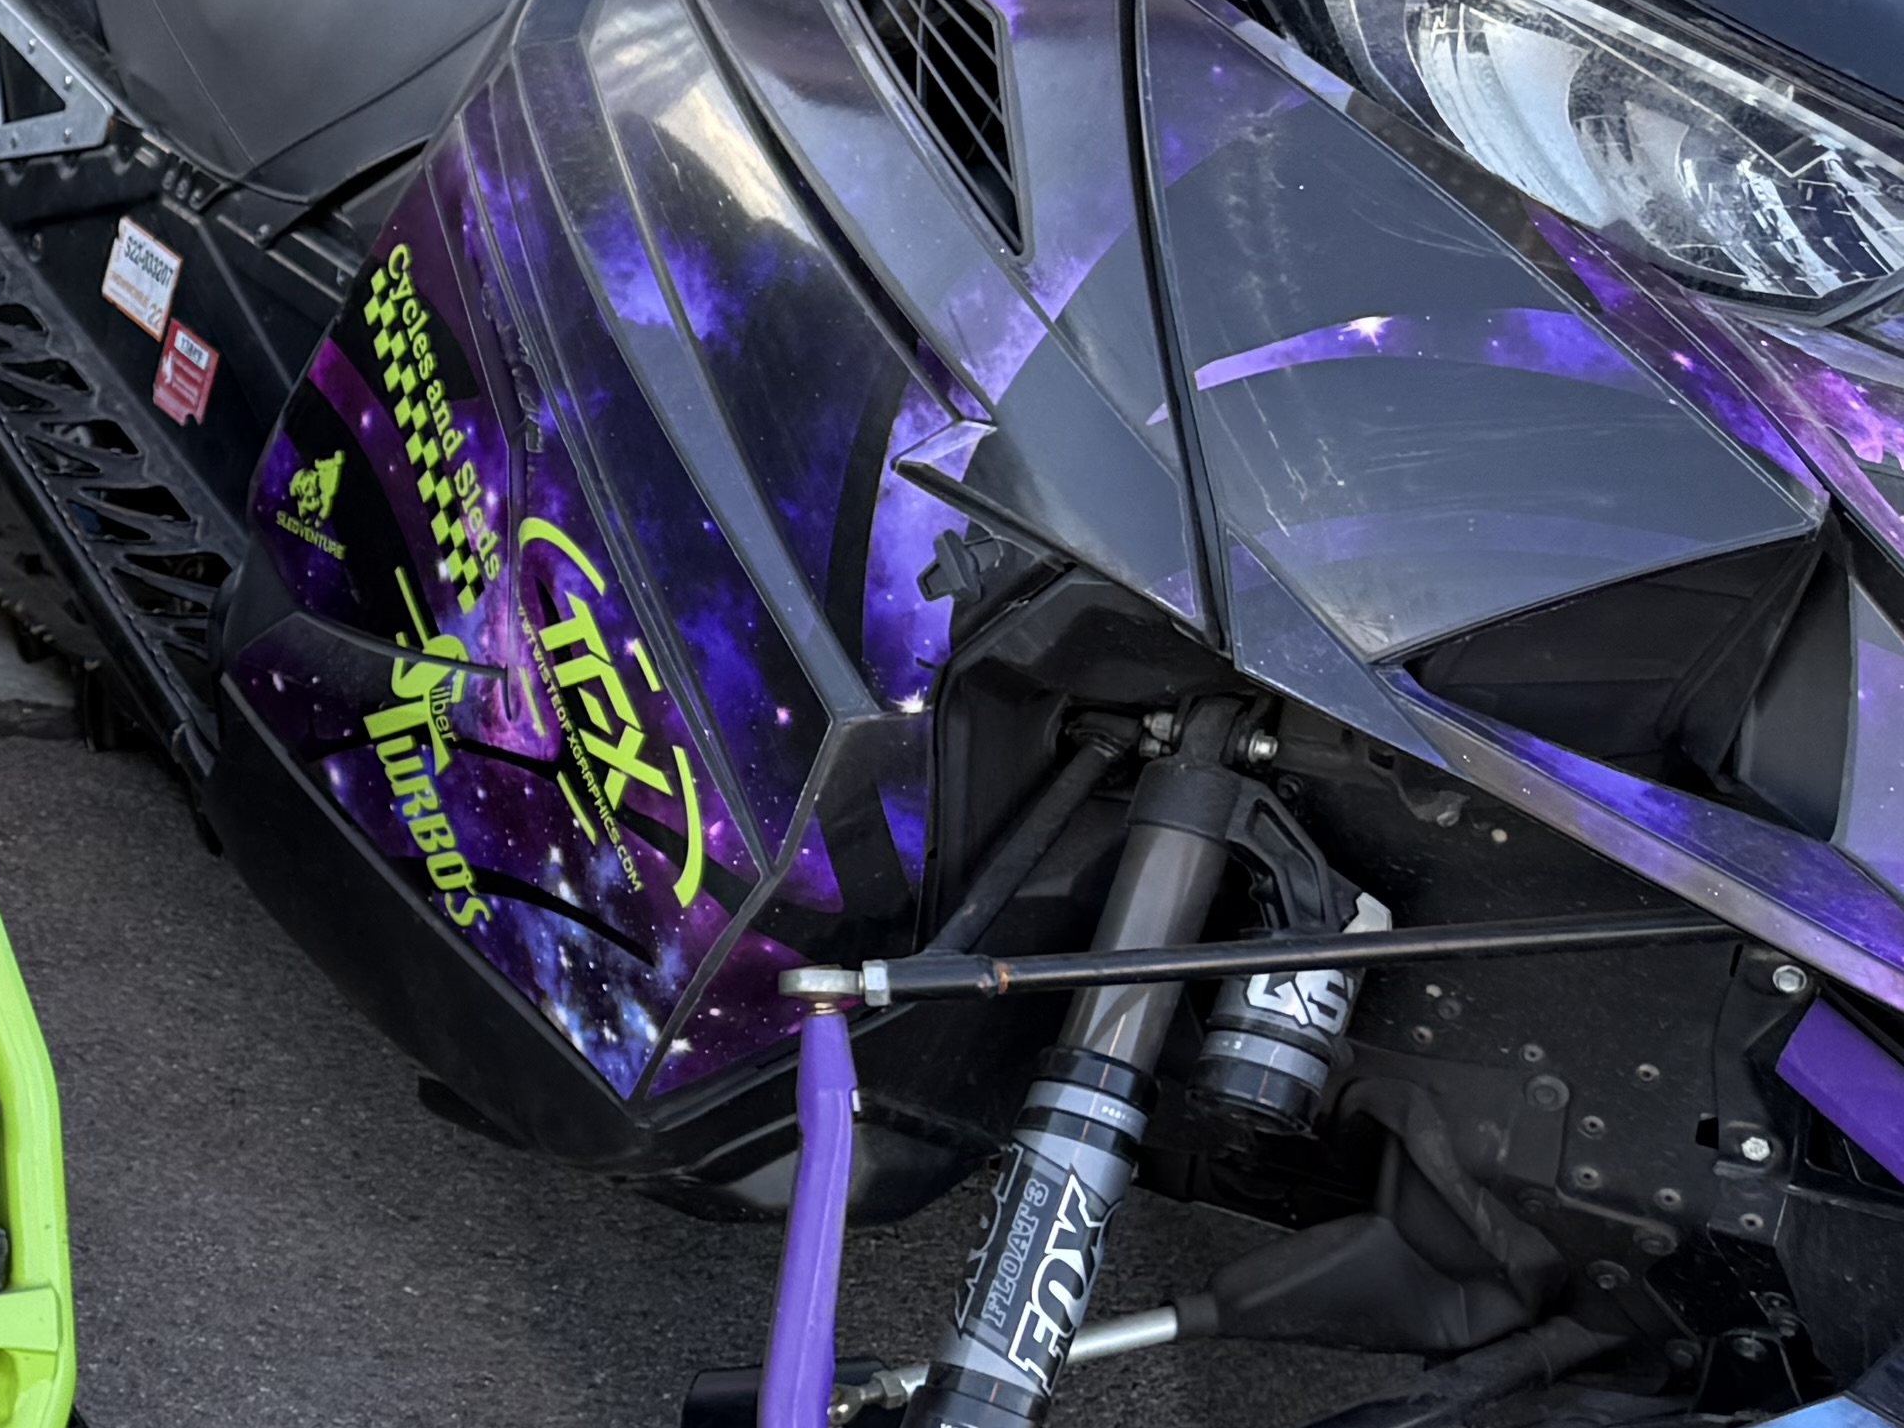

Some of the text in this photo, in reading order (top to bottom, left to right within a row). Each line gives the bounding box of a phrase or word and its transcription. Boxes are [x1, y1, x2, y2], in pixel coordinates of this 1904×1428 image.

[388, 243, 500, 581] Cycles and Sleds
[275, 510, 347, 561] SLEDVENTURE
[1246, 969, 1355, 1036] QS
[981, 1204, 1044, 1329] FLOAT
[1024, 1177, 1049, 1207] 3
[1007, 1173, 1108, 1397] FOX
